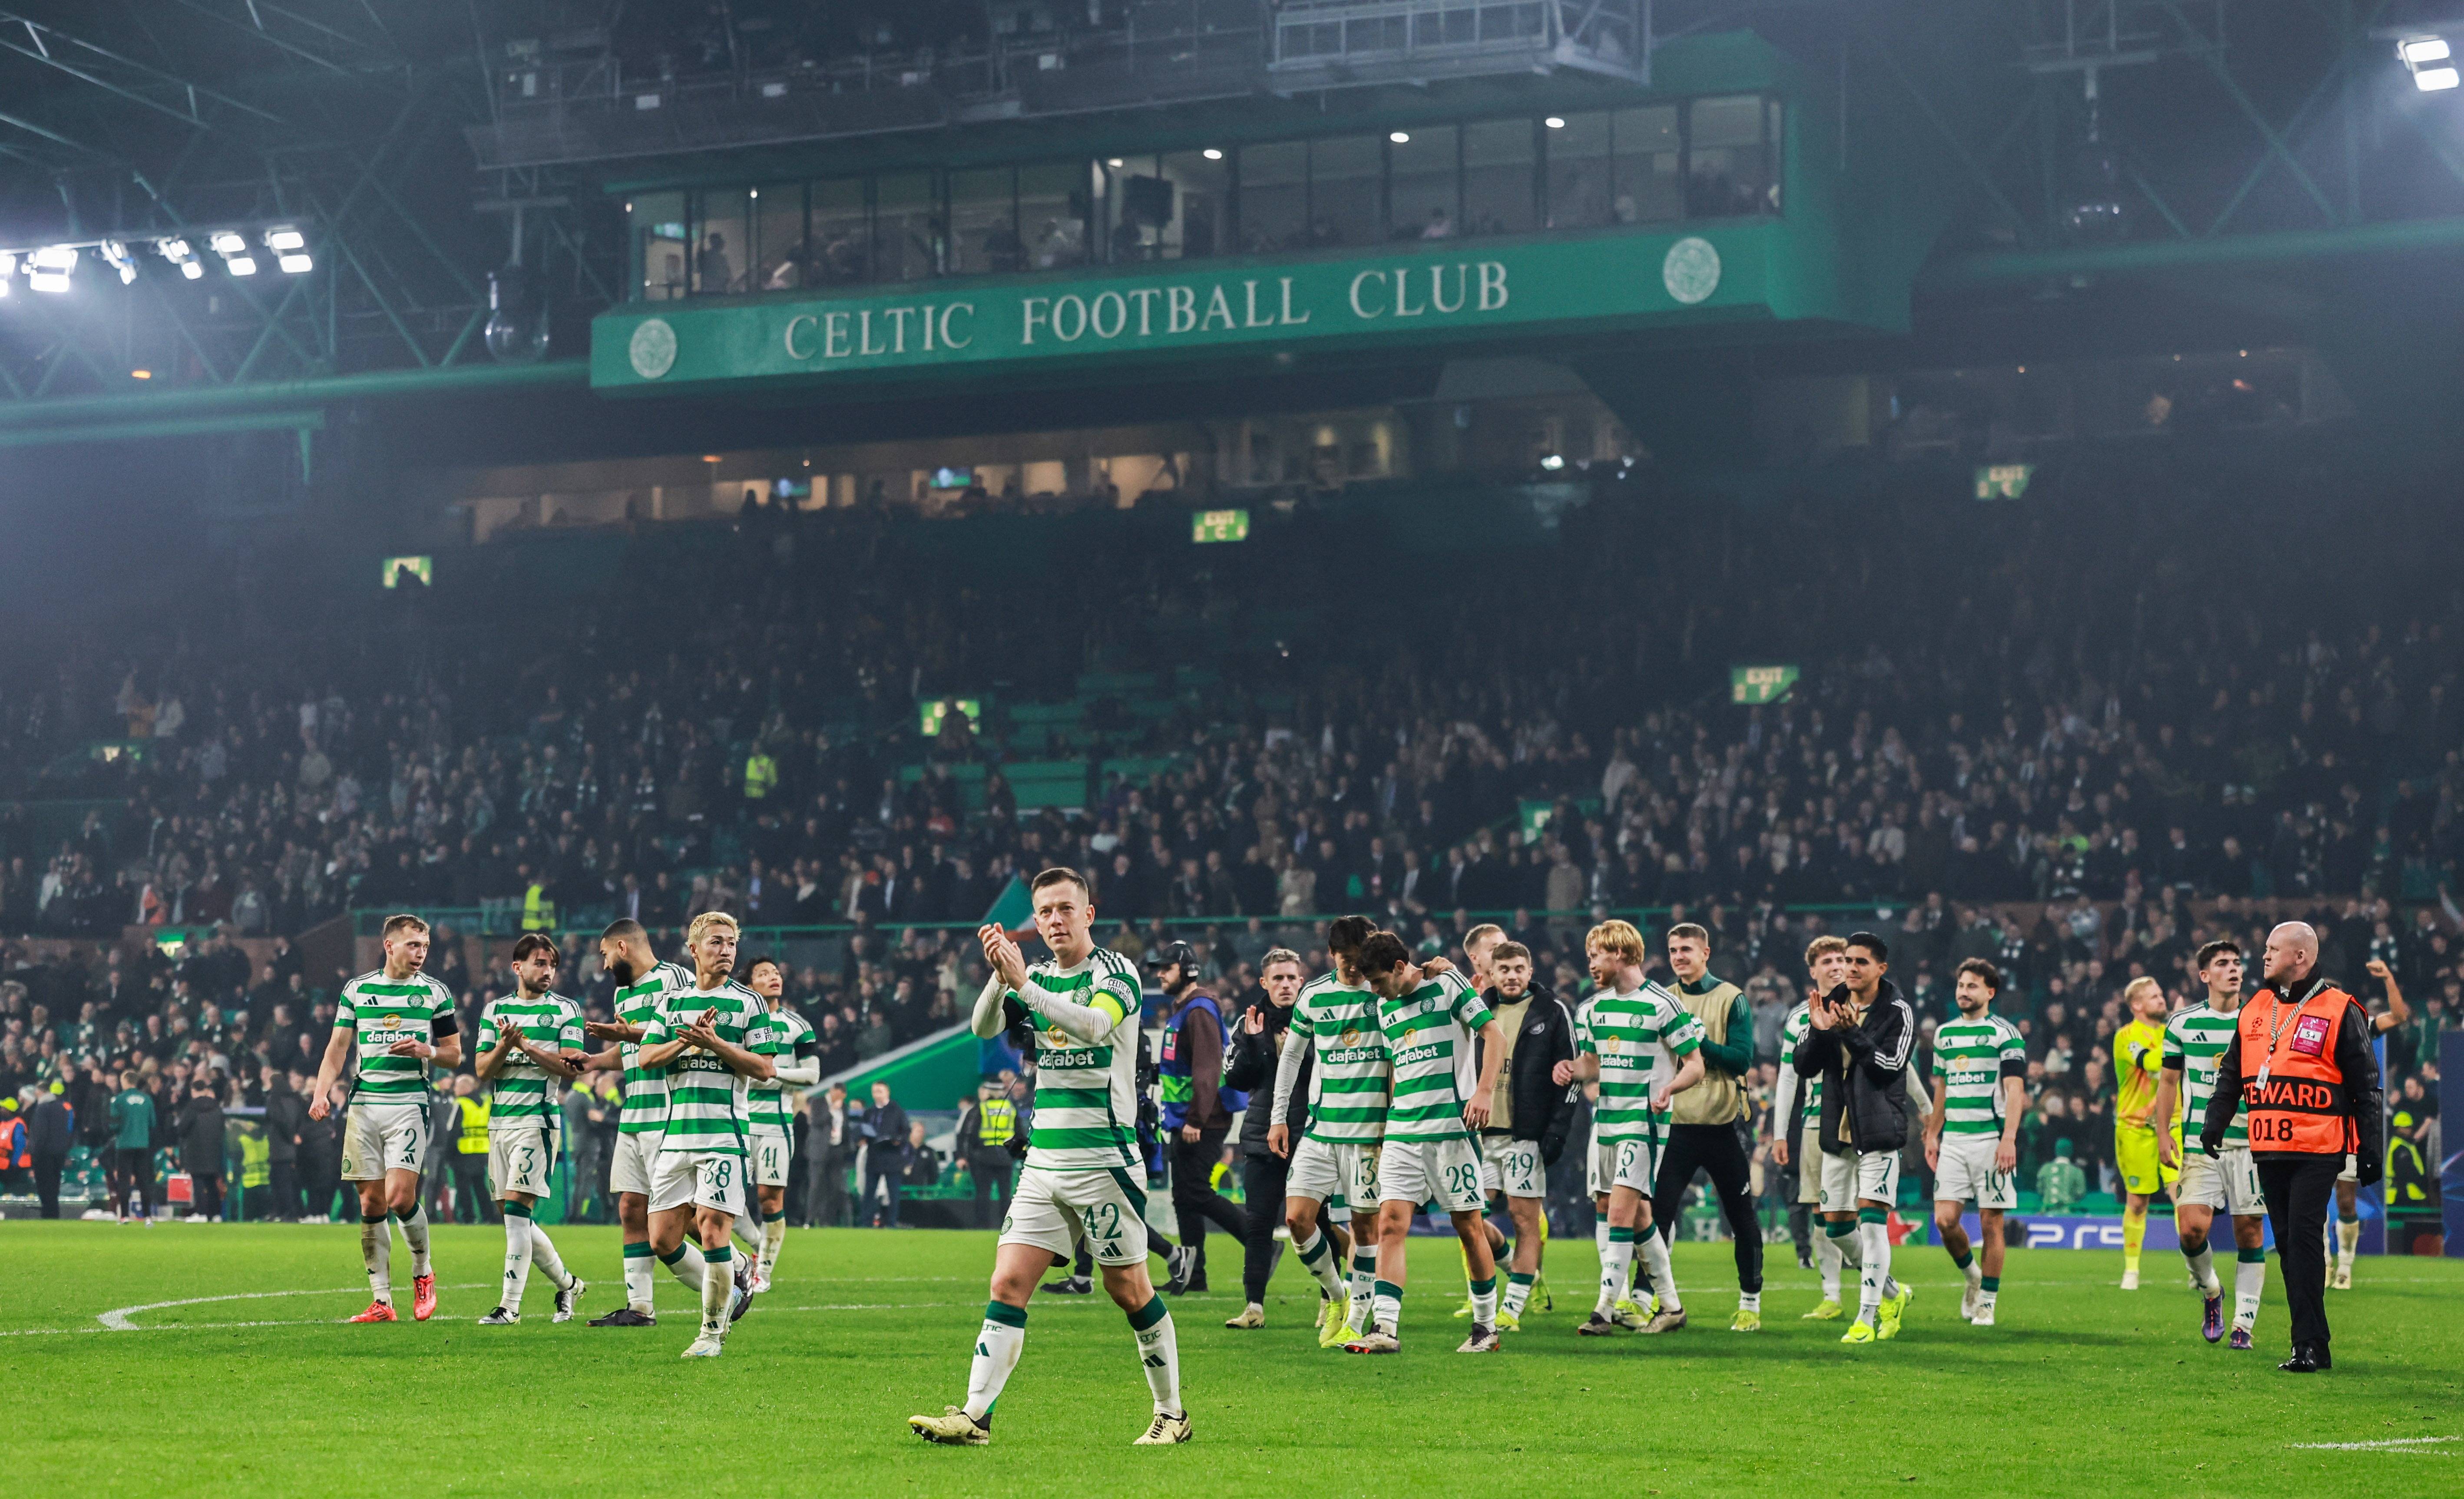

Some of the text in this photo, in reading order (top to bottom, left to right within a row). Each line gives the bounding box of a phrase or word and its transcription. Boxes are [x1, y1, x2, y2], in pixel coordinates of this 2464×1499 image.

[785, 261, 1509, 361] CELTIC FOOTBALL CLUB
[1746, 667, 1783, 684] EXIT
[1108, 979, 1126, 990] CELTIC
[367, 1030, 417, 1044] dafabet
[1038, 1049, 1094, 1070] dafabet
[1327, 1047, 1380, 1064] dafabet
[1395, 1045, 1439, 1066] dafabet
[1947, 1071, 1986, 1085] dafabet
[2243, 1082, 2332, 1109] TEWARD
[404, 1128, 416, 1152] 2
[2253, 1118, 2293, 1142] 018
[519, 1148, 534, 1173] 3
[761, 1146, 777, 1168] 41
[1621, 1143, 1638, 1167] 5
[704, 1158, 731, 1188] 38
[1355, 1158, 1376, 1186] 13
[1446, 1163, 1477, 1193] 28
[1881, 1156, 1893, 1182] 7
[1984, 1169, 2006, 1191] 10
[1084, 1203, 1122, 1240] 42
